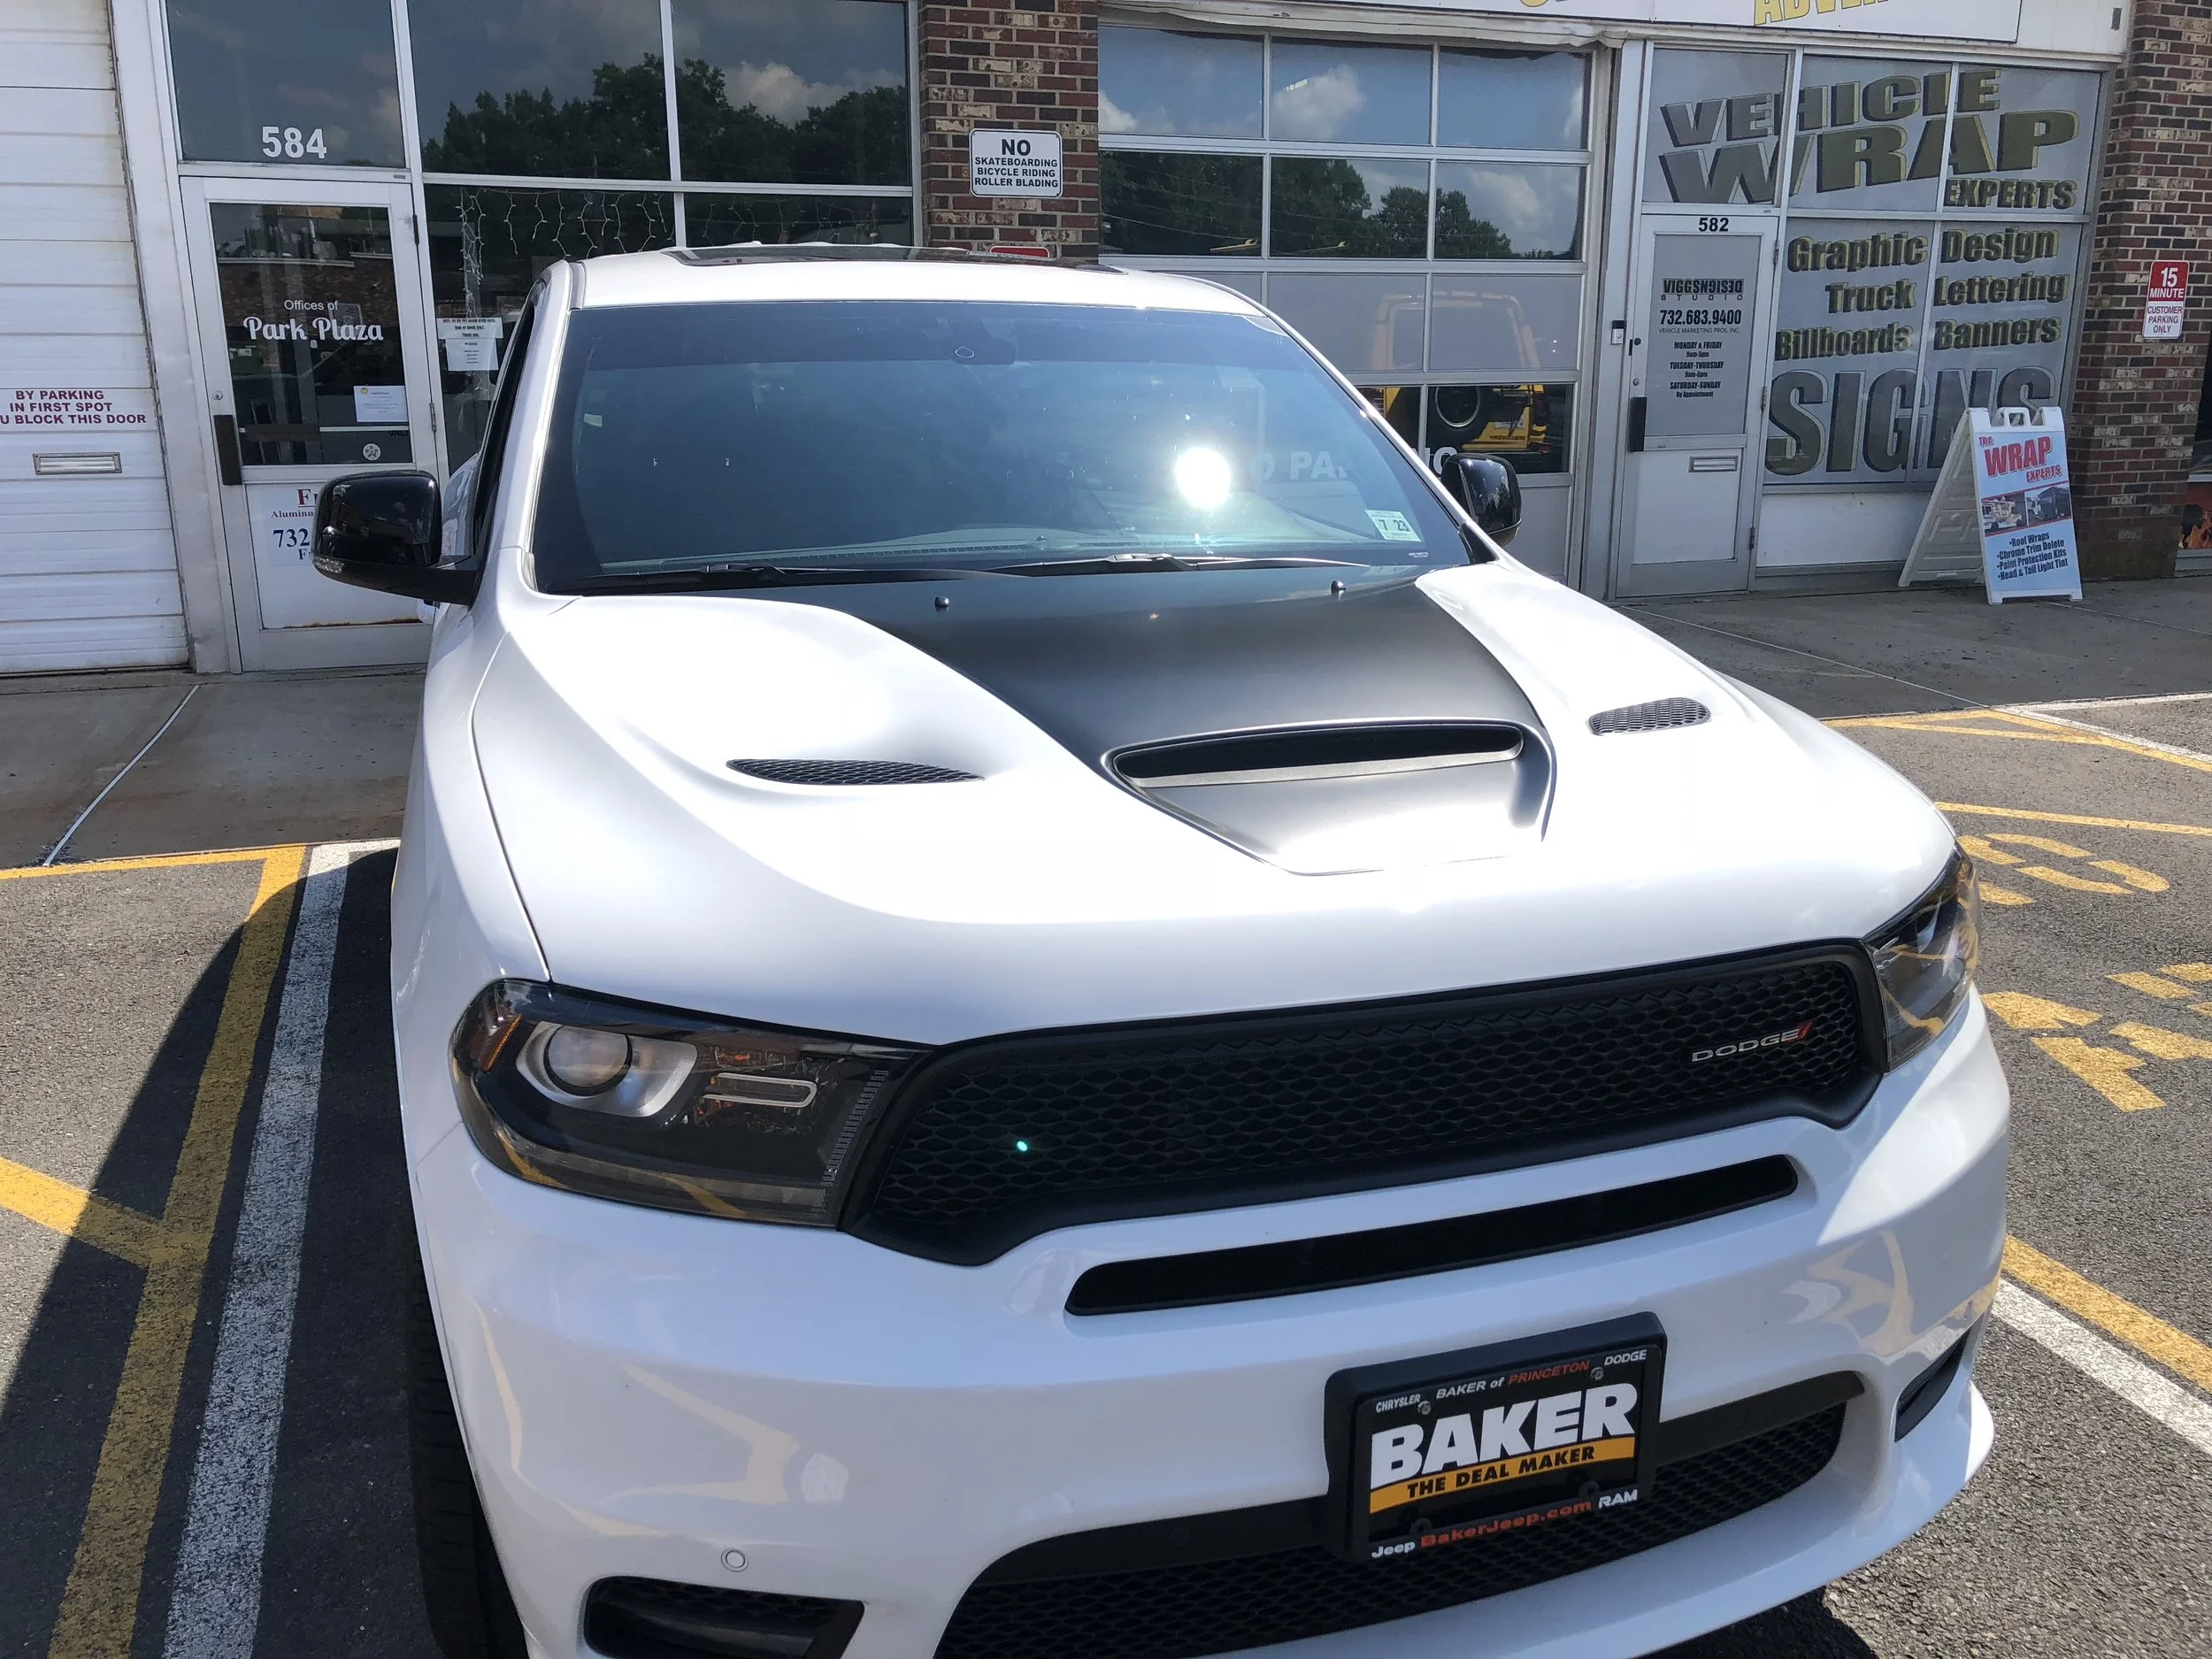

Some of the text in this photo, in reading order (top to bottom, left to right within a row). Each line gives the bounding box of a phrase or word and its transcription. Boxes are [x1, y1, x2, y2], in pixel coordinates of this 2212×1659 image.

[1660, 69, 2001, 147] VEHICLE
[262, 126, 327, 159] 584
[1002, 139, 1031, 156] NO
[974, 157, 1058, 168] SKATEBOARDING
[1658, 110, 2080, 204] WRAP
[977, 167, 1056, 178] BICYCLE RIDING
[974, 177, 1058, 188] ROLLER BLADING
[1946, 178, 2078, 210] EXPERTS
[1698, 217, 1729, 232] 582
[1787, 226, 2060, 273] Graphic Design
[2161, 267, 2178, 288] 15
[1824, 271, 2070, 314] Truck Lettering
[2149, 288, 2185, 298] MINUTE
[284, 300, 338, 311] Offices of
[1659, 309, 1742, 326] 732.683.9400
[242, 316, 384, 341] Park Plaza
[1774, 317, 2062, 361] Billboards Banners
[1670, 361, 1724, 370] TUESDAY-THURSDAY
[15, 390, 104, 400] BY PARKING
[10, 402, 112, 412] IN FIRST SPOT
[15, 414, 64, 424] BLOCK
[68, 414, 102, 424] THIS
[106, 414, 146, 423] DOOR
[1978, 436, 1993, 446] The
[1984, 436, 2053, 477] WRAP
[2025, 464, 2062, 483] EXPERTS
[1379, 518, 1409, 532] 7 23
[2028, 533, 2050, 544] Wraps
[2000, 540, 2065, 560] Chrome Trim Delete
[2000, 549, 2067, 571] Paint Protection Kits
[2001, 569, 2017, 580] Head
[2025, 565, 2037, 576] Tail
[2038, 561, 2055, 573] Light
[2055, 558, 2069, 569] Tint
[1692, 1028, 1800, 1062] DODGE
[1604, 1349, 1647, 1366] DODGE
[1436, 1360, 1590, 1400] BAKER of PRINCETON
[1376, 1394, 1421, 1413] CHRYSLER
[1371, 1383, 1637, 1490] BAKER
[1407, 1446, 1595, 1499] THE DEAL MAKER
[1371, 1489, 1638, 1559] Jeep BakerJeep.com RAM
